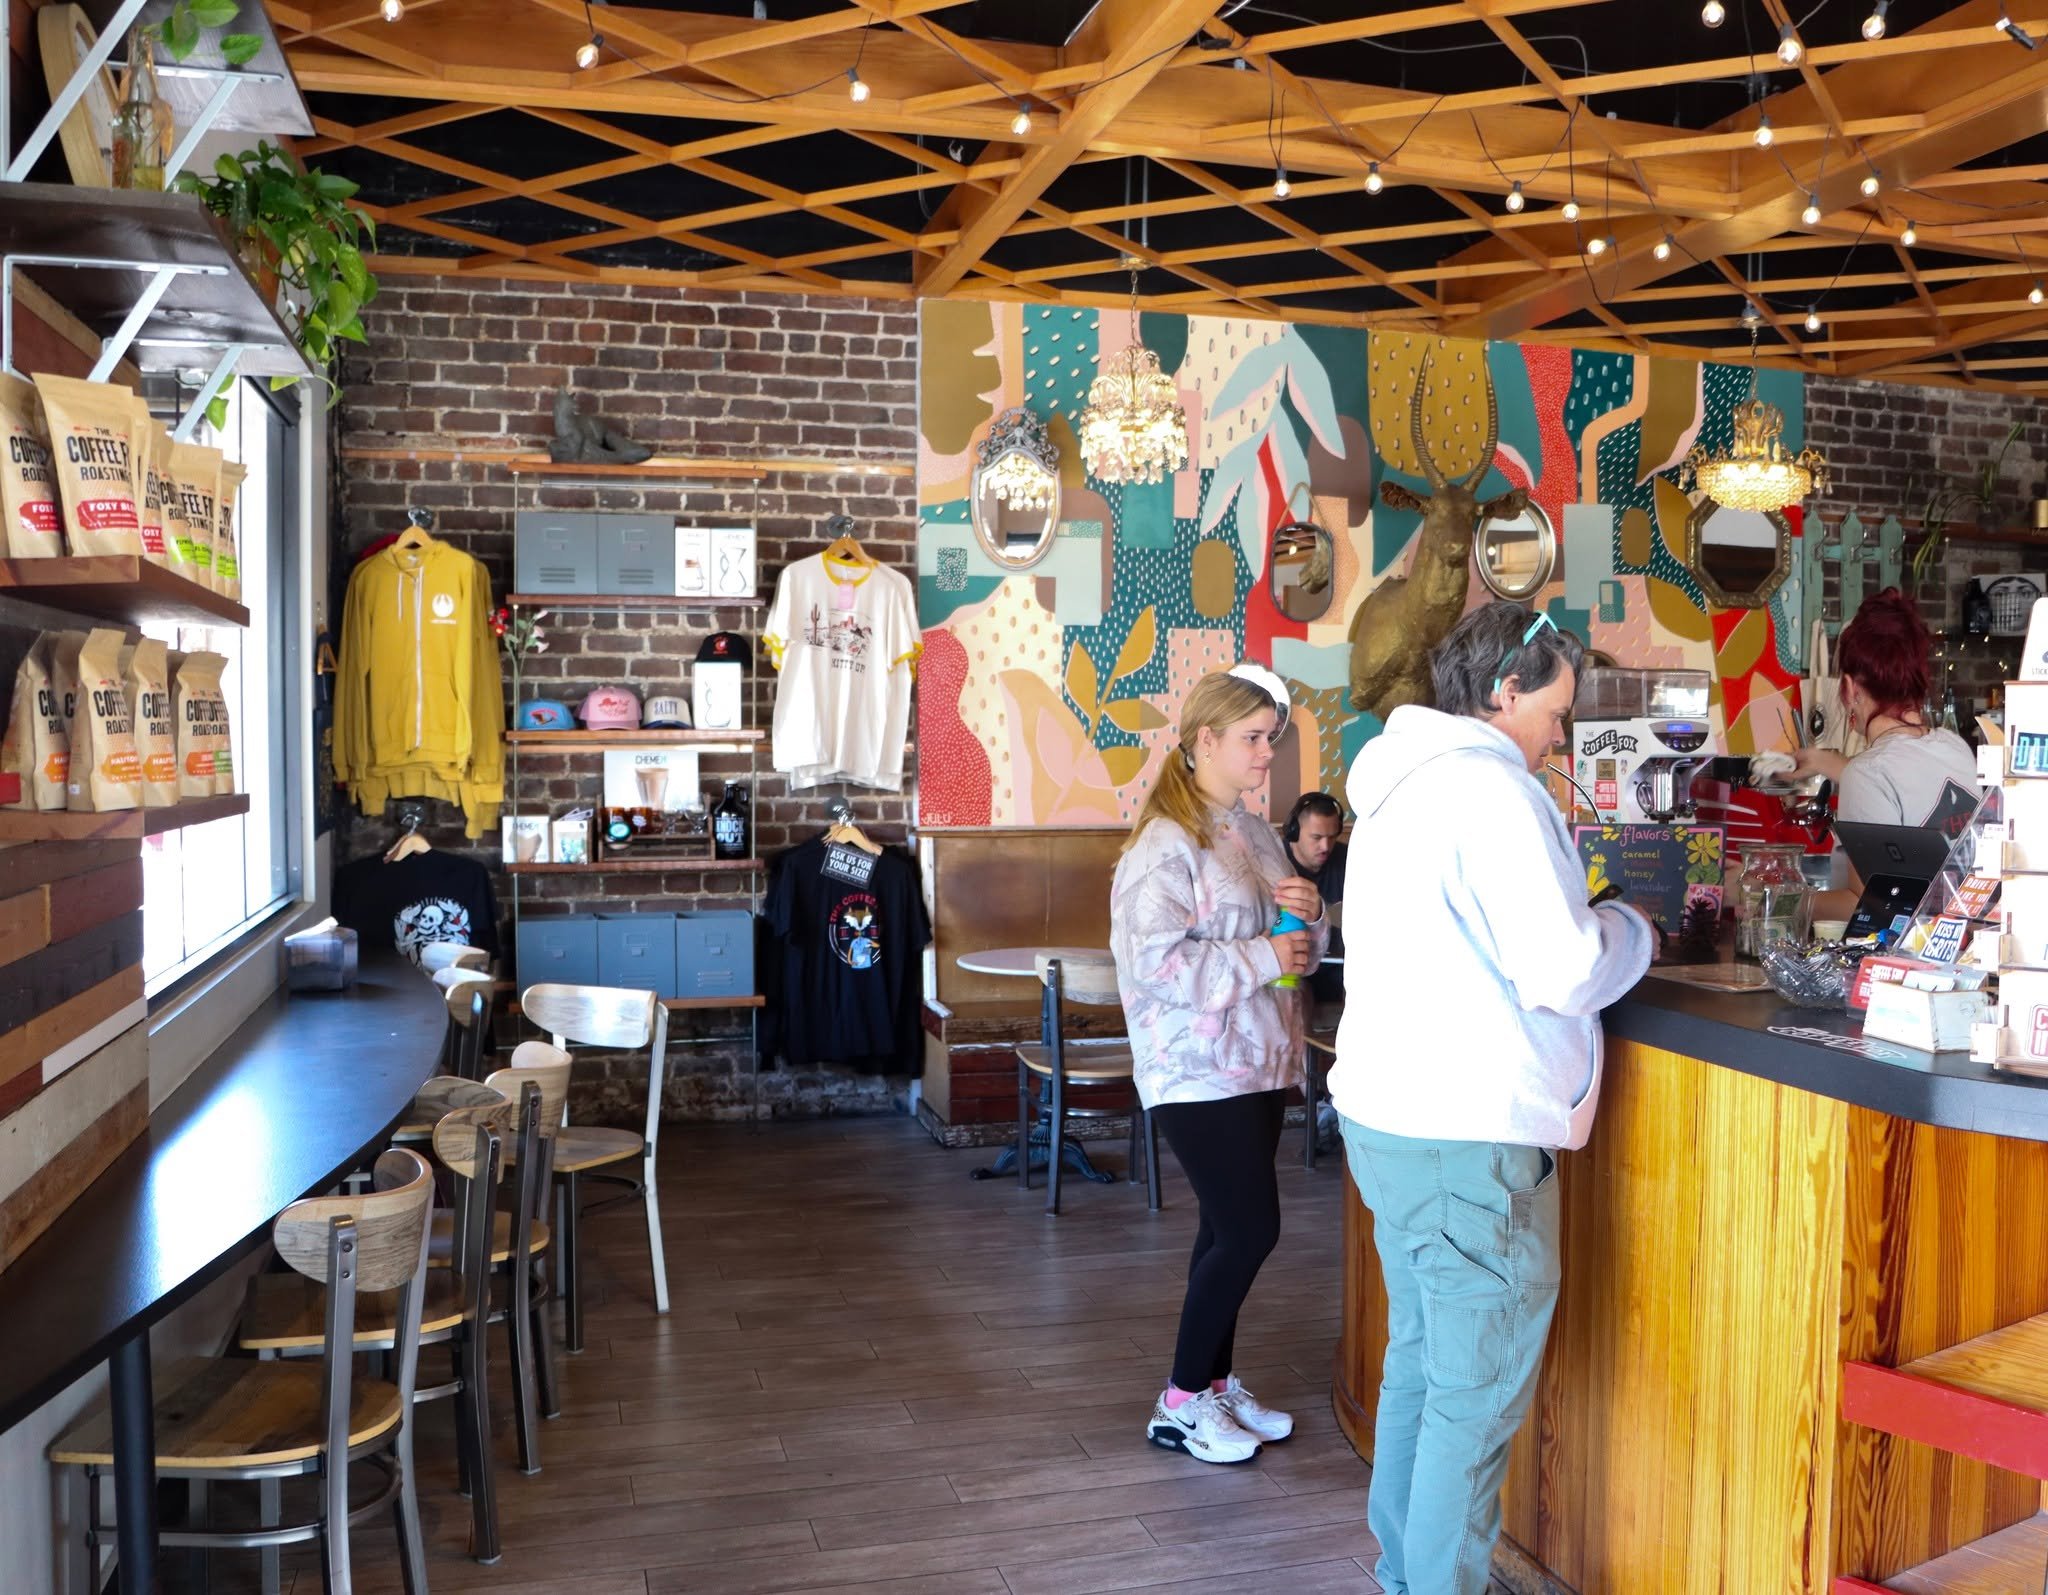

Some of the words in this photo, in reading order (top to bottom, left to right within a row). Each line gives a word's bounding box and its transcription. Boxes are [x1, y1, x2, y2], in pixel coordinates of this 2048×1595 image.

[95, 427, 112, 437] THE
[67, 435, 121, 465] COFFEE
[88, 503, 117, 511] FOXY
[143, 528, 161, 537] OXY
[654, 700, 677, 715] SALTY
[1584, 730, 1616, 755] COFFEE
[1619, 737, 1636, 751] FOX
[716, 832, 744, 843] OUT
[1620, 825, 1670, 847] flavors
[830, 850, 846, 861] ASK
[846, 855, 856, 865] US
[857, 859, 872, 871] FOR
[1622, 849, 1660, 859] caramel
[829, 859, 849, 872] YOUR
[850, 866, 869, 880] SIZE!
[1624, 869, 1655, 881] honey
[1630, 880, 1672, 893] lavender
[1965, 878, 1989, 891] DRIVE
[1935, 922, 1954, 939] KISS
[1924, 938, 1958, 961] GRITS
